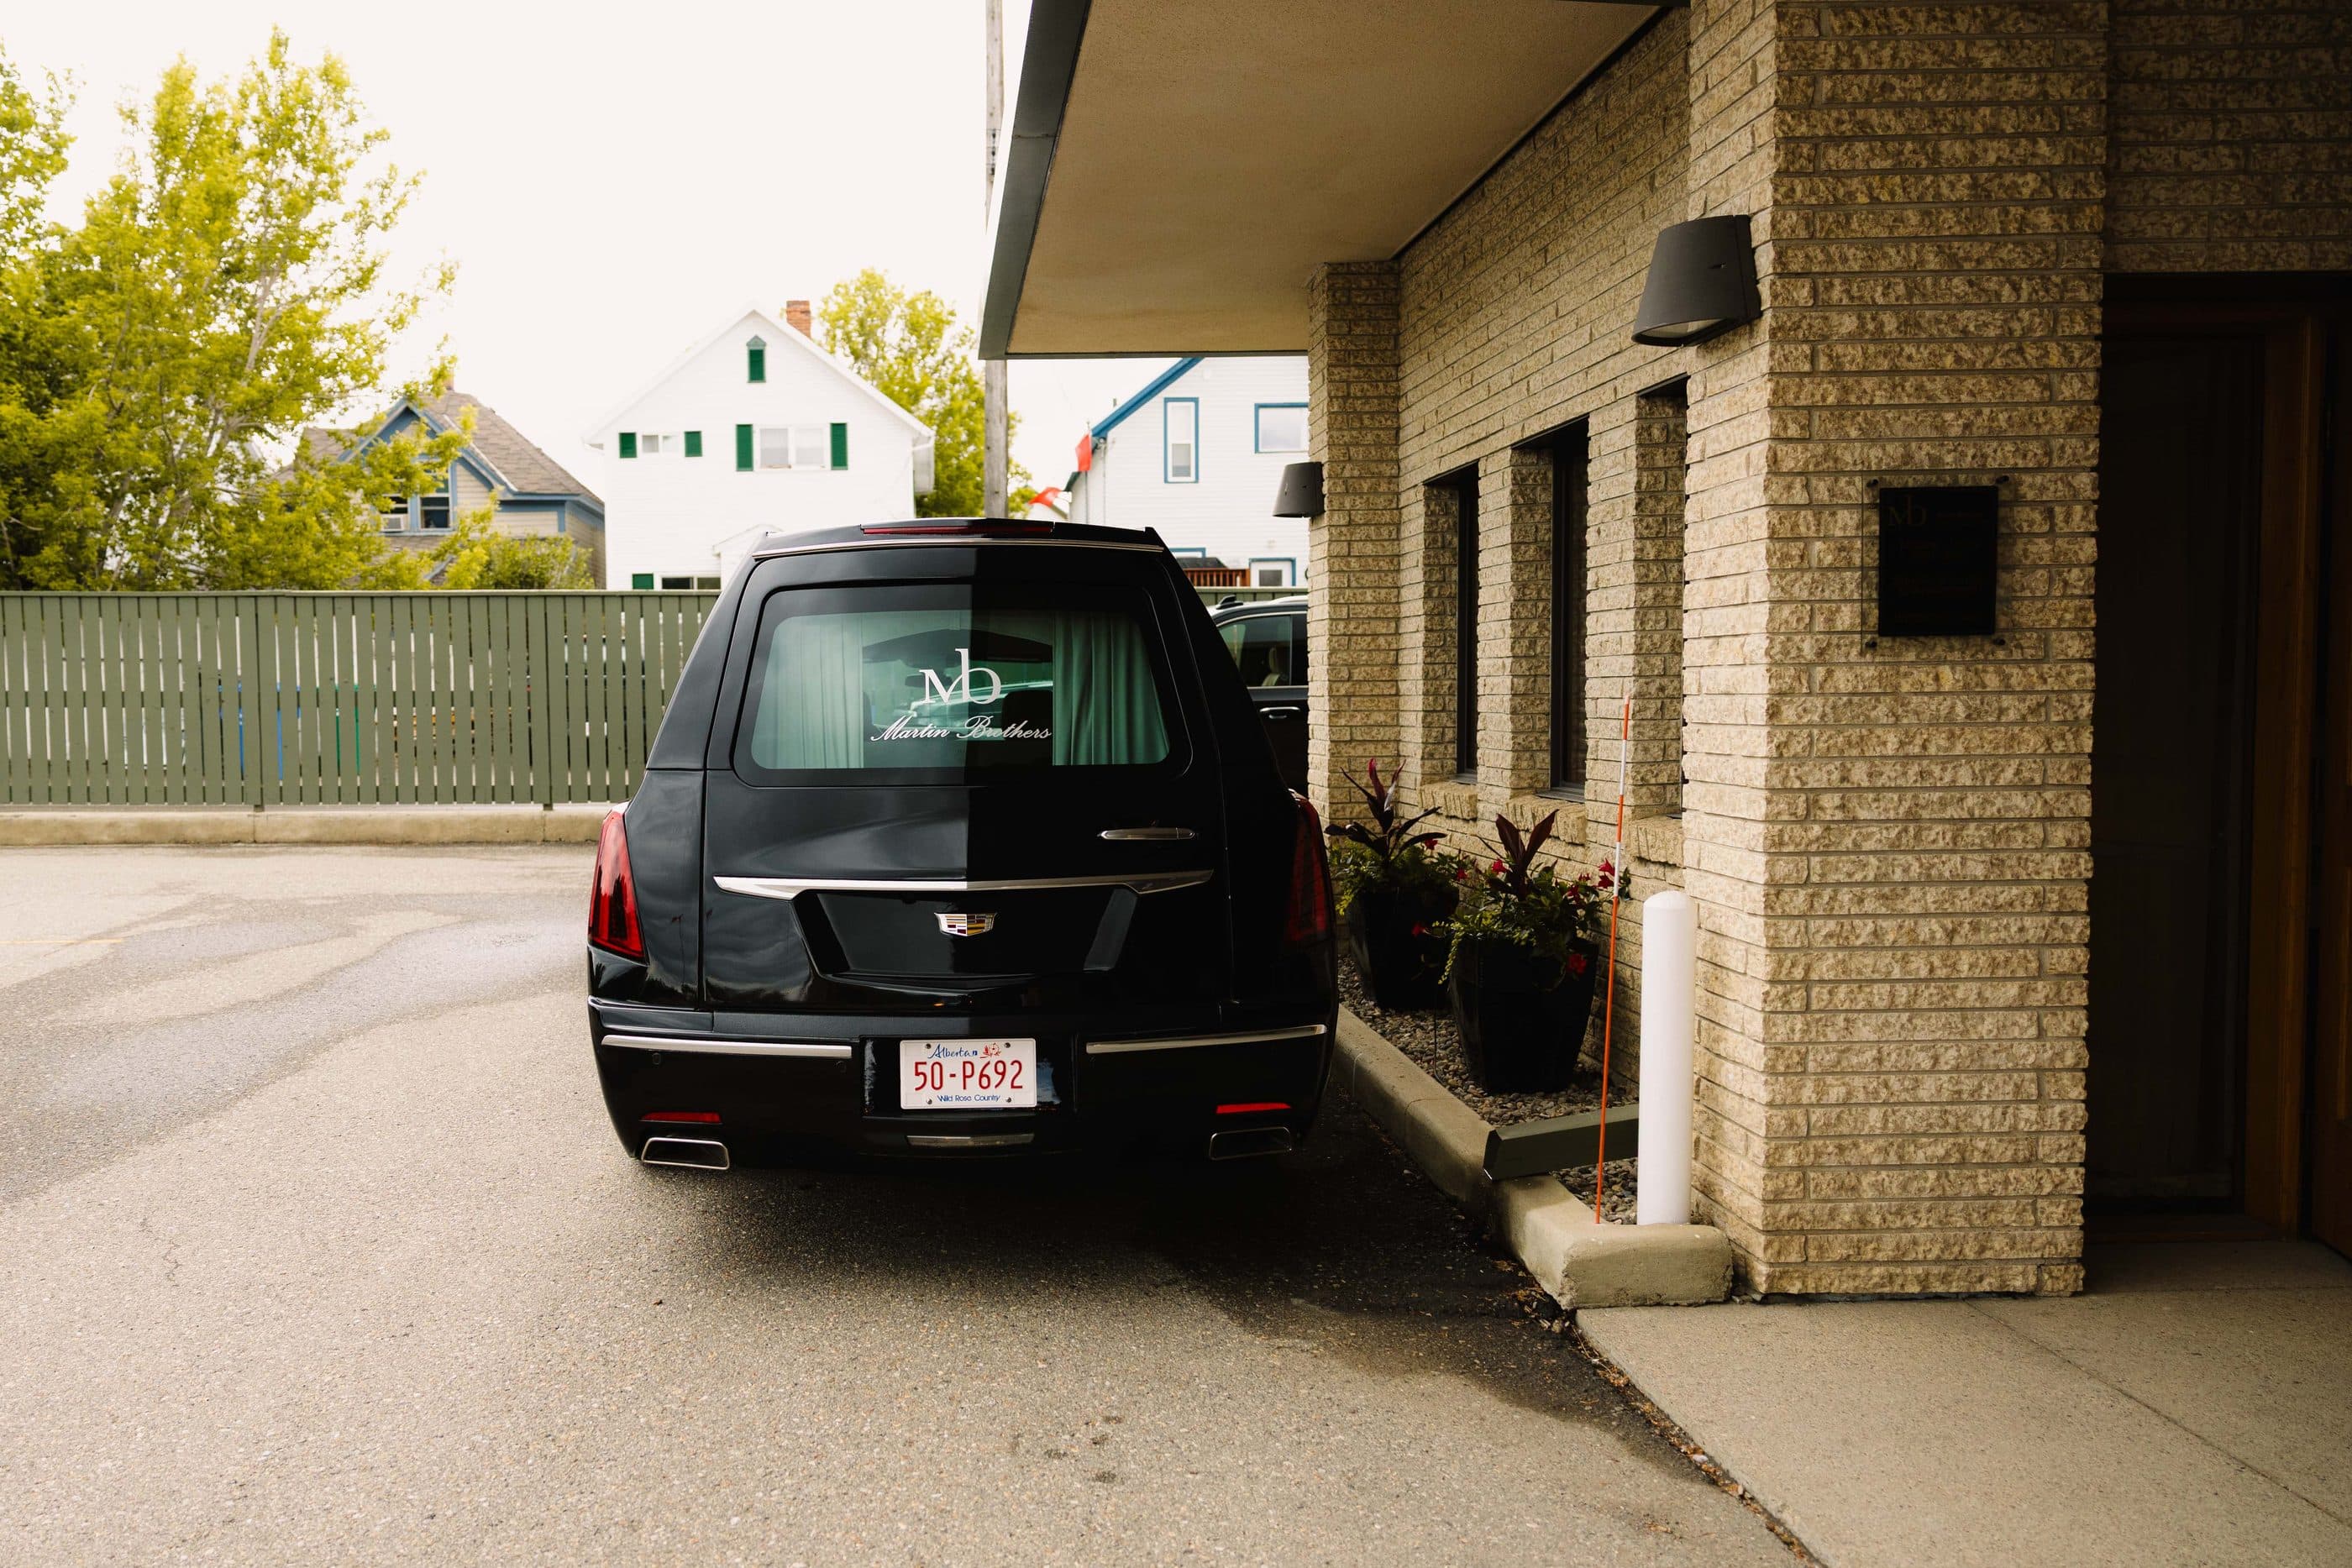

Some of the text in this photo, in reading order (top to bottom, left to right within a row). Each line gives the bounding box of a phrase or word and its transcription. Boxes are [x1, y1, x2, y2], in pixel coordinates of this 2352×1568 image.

[870, 715, 1052, 742] Martin Brothers
[927, 1043, 972, 1059] Alberta
[914, 1060, 1023, 1091] 50-P692
[937, 1093, 1001, 1103] Wild Rose Country
